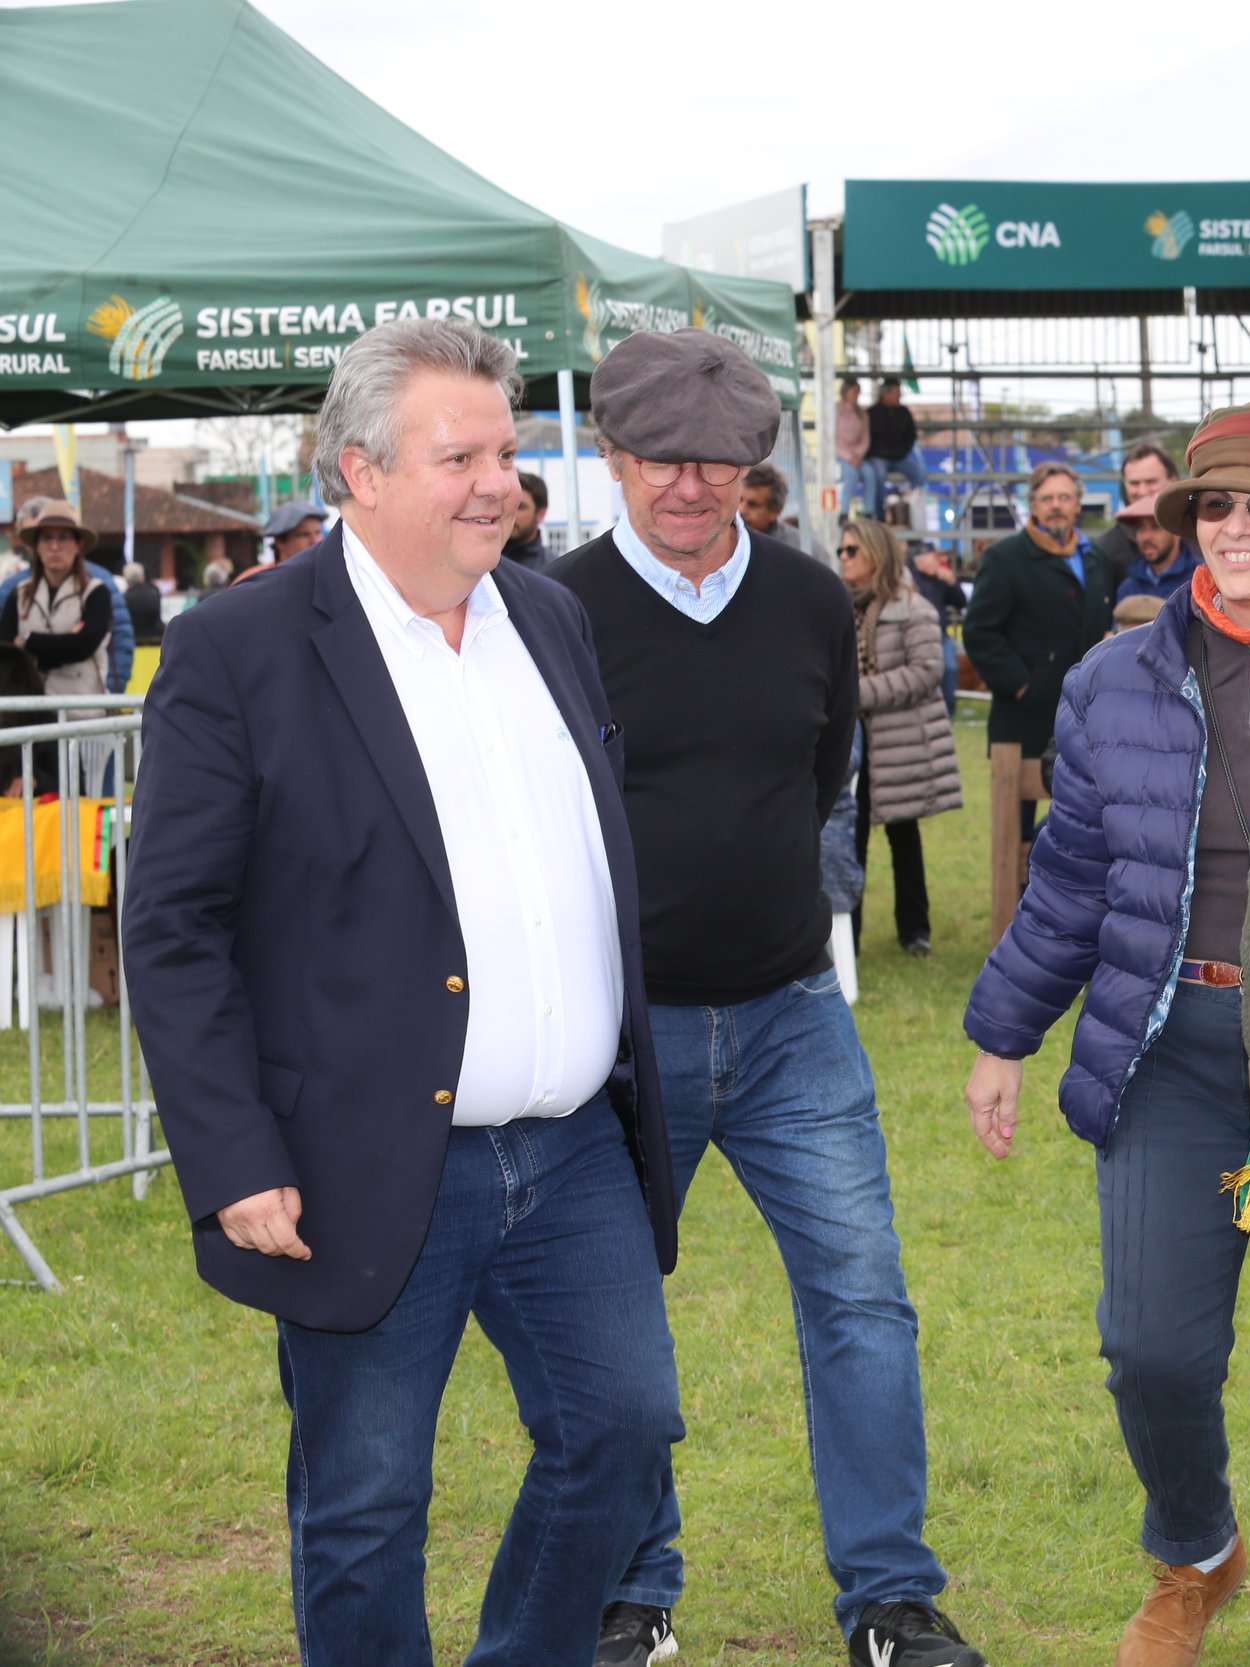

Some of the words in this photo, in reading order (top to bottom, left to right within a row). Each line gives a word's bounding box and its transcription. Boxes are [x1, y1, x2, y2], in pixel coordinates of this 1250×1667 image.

[995, 220, 1062, 249] CNA
[1198, 241, 1243, 257] FARSUL
[196, 302, 367, 339] SISTEMA
[374, 293, 528, 328] FARSUL
[0, 353, 71, 375] RURAL
[197, 347, 283, 371] FARSUL
[294, 344, 350, 368] SEN
